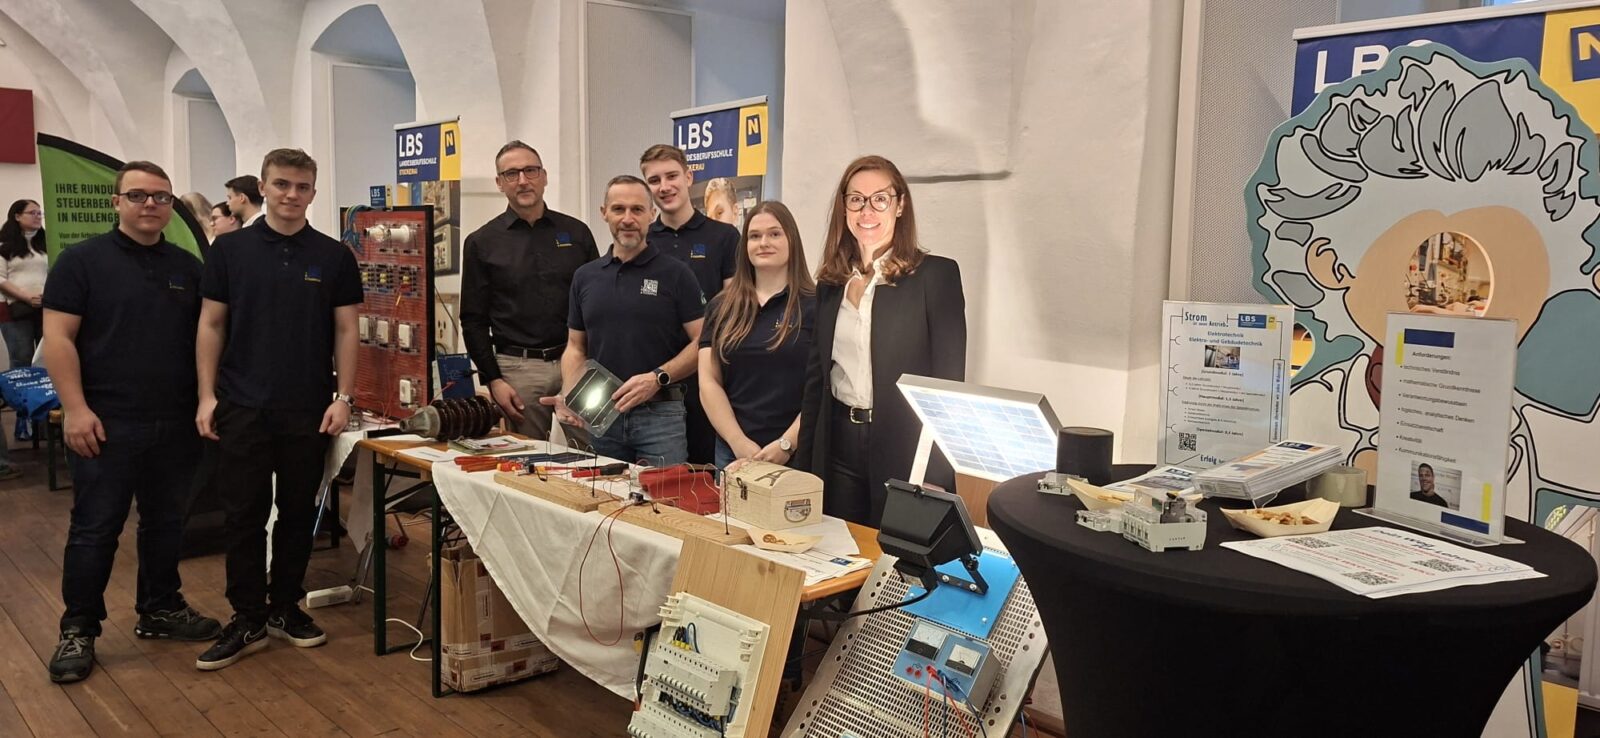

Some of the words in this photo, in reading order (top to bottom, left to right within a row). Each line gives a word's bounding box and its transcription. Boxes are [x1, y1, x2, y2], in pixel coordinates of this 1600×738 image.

[1314, 39, 1432, 94] LB
[748, 119, 758, 135] N
[678, 121, 713, 150] LBS
[399, 132, 423, 157] LBS
[686, 149, 733, 161] DESBERUFSSCHULE
[55, 183, 78, 194] IHRE
[81, 184, 113, 194] RUNDU
[56, 198, 113, 208] STEUERBER
[58, 212, 68, 222] IN
[72, 212, 119, 223] NEULENGB
[1185, 312, 1208, 321] Strom
[1200, 454, 1217, 465] Erfolg
